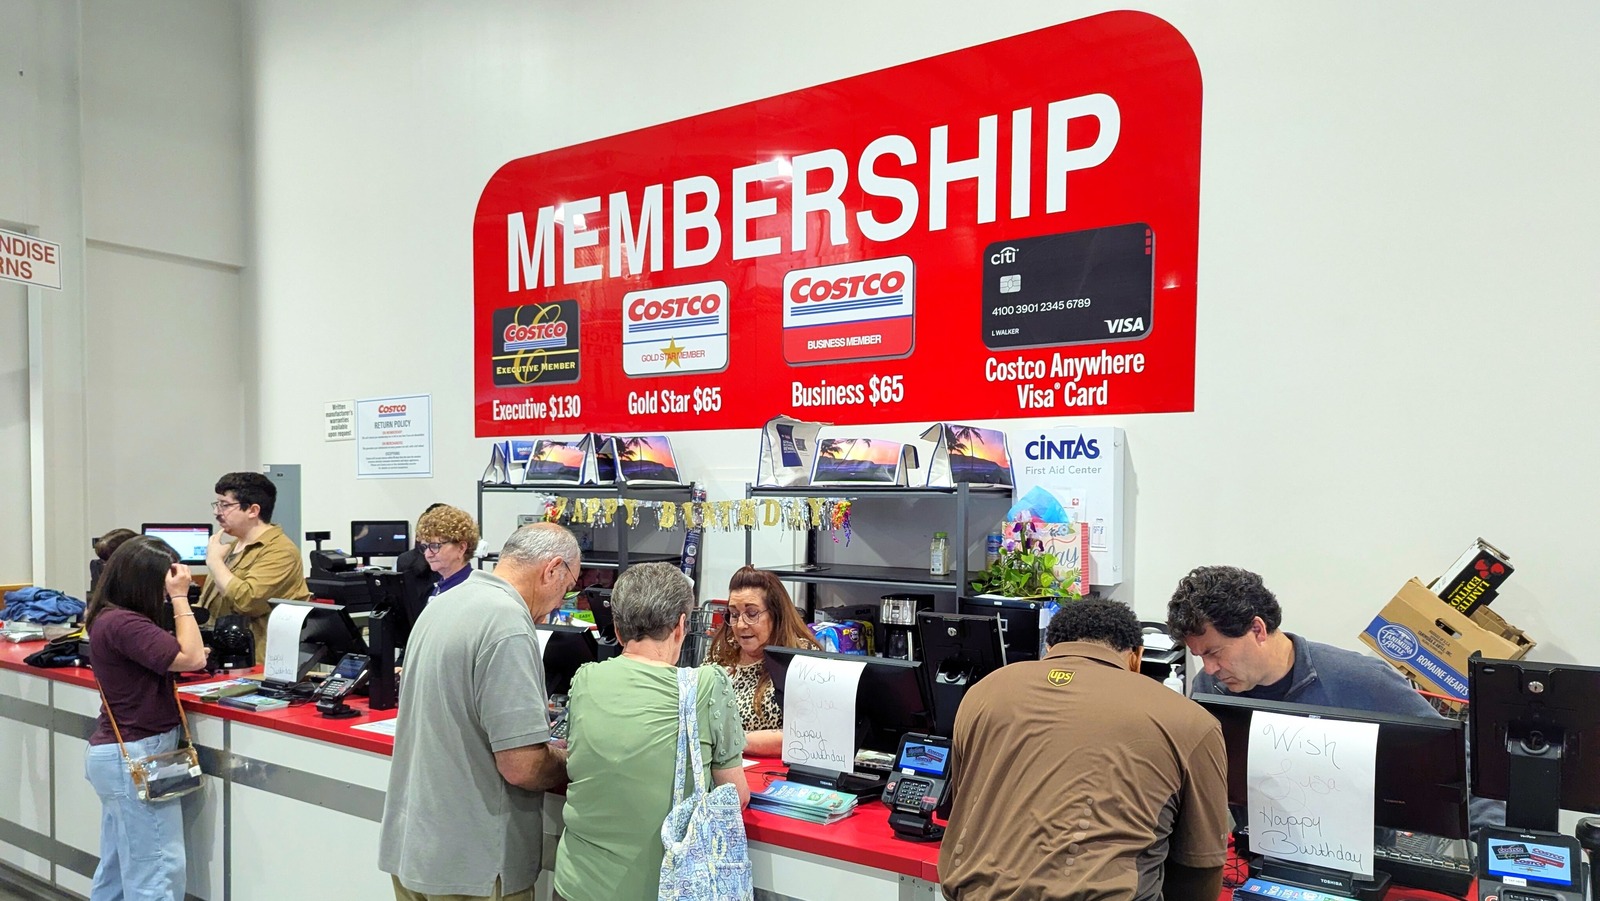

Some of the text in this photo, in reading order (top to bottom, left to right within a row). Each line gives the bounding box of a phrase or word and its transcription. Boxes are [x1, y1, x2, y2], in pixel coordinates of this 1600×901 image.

[507, 92, 1122, 293] MEMBERSHIP
[991, 246, 1016, 265] citi
[790, 270, 905, 304] COSTCO
[628, 293, 721, 322] COSTCO
[991, 297, 1091, 316] 4100 3901 2345 6789
[504, 321, 568, 342] COSTCO
[995, 327, 1020, 336] WALKER
[1104, 316, 1145, 333] VISA
[807, 334, 882, 350] BUSINESS MEMBER
[641, 353, 659, 362] GOLD
[985, 350, 1145, 381] Costco Anywhere
[628, 386, 722, 415] Gold Star $65
[792, 374, 904, 407] Business $65
[1063, 380, 1108, 406] Card
[378, 404, 407, 413] COSTCO
[492, 395, 581, 421] Executive $130
[374, 420, 411, 429] RETURN POLICY
[1025, 465, 1102, 475] First Aid Center
[1382, 629, 1414, 655] TANIMURA
[1385, 639, 1407, 656] ANTLE
[1050, 670, 1072, 682] ups
[1416, 654, 1469, 697] ROMAINE HEARTS
[789, 721, 828, 751] Happy
[1262, 723, 1340, 770] Wish
[1259, 806, 1322, 839] Happy
[1320, 878, 1343, 887] TOSHIBA
